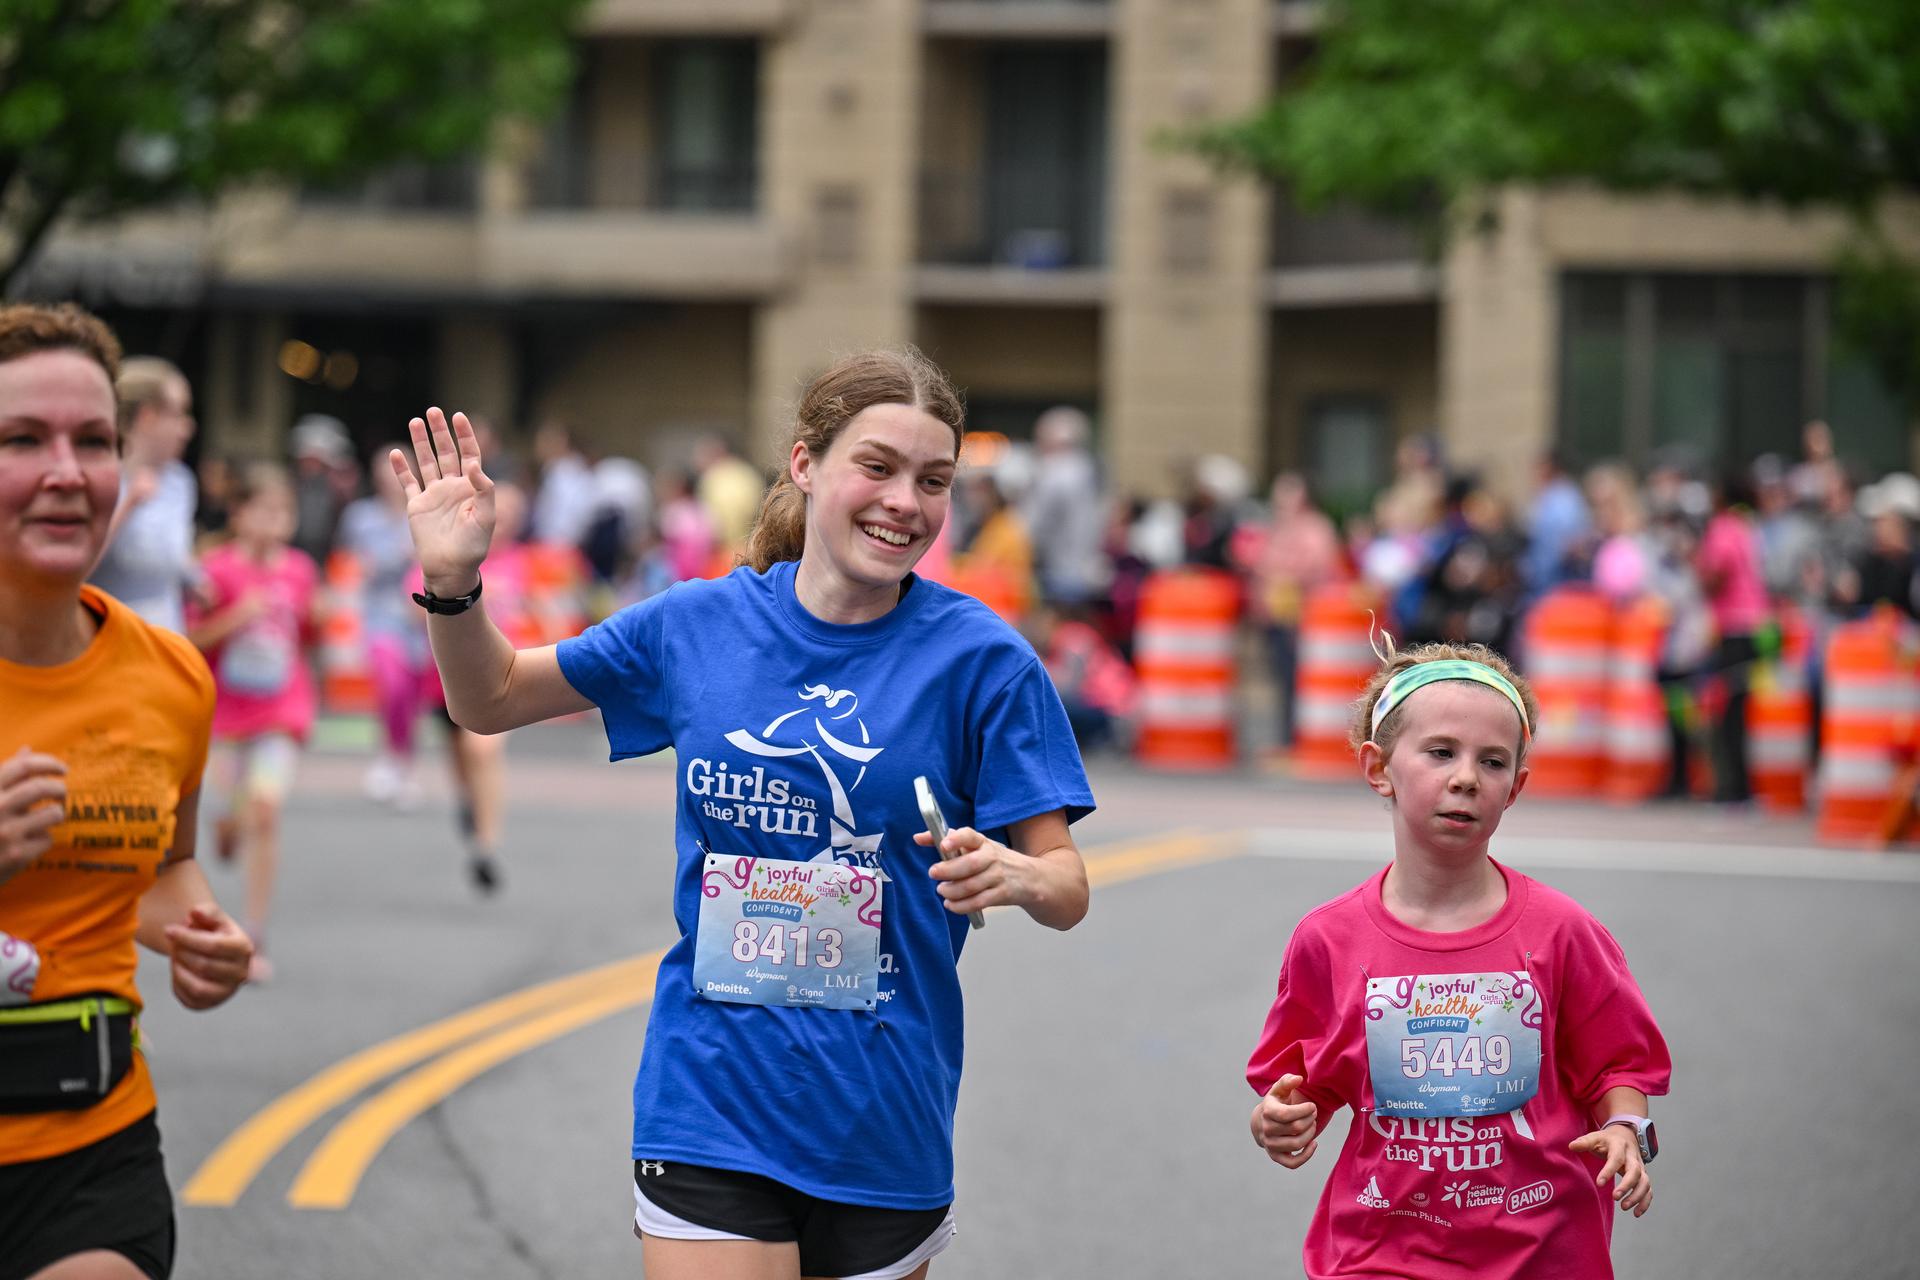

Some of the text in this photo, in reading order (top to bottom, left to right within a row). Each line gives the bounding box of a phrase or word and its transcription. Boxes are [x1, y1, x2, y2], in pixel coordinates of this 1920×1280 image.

[687, 758, 817, 809] Girls on
[702, 800, 818, 837] the run
[831, 844, 880, 868] 5K
[767, 866, 813, 885] joyful
[751, 881, 820, 909] healthy
[746, 904, 799, 917] CONFIDENT
[731, 920, 843, 969] 8413
[744, 966, 788, 983] Wegmans
[824, 973, 862, 989] LMI
[706, 982, 752, 995] Deloitte.
[800, 988, 824, 999] Cigna
[1428, 979, 1476, 999] joyful
[1415, 995, 1484, 1020] healthy
[1411, 1020, 1465, 1030] CONFIDENT
[1401, 1035, 1511, 1078] 5449
[1417, 1081, 1461, 1096] Wegmans
[1496, 1077, 1527, 1094] LMI
[1386, 1099, 1427, 1110] Deloitte.
[1473, 1096, 1496, 1106] Cigna
[1477, 1125, 1503, 1140] on
[1385, 1141, 1503, 1172] the run
[1466, 1194, 1503, 1208] futures
[1467, 1186, 1506, 1199] healthy
[1511, 1185, 1549, 1209] BAND
[1356, 1194, 1390, 1209] adidas
[1419, 1211, 1433, 1222] Phi
[1434, 1216, 1452, 1228] Beta
